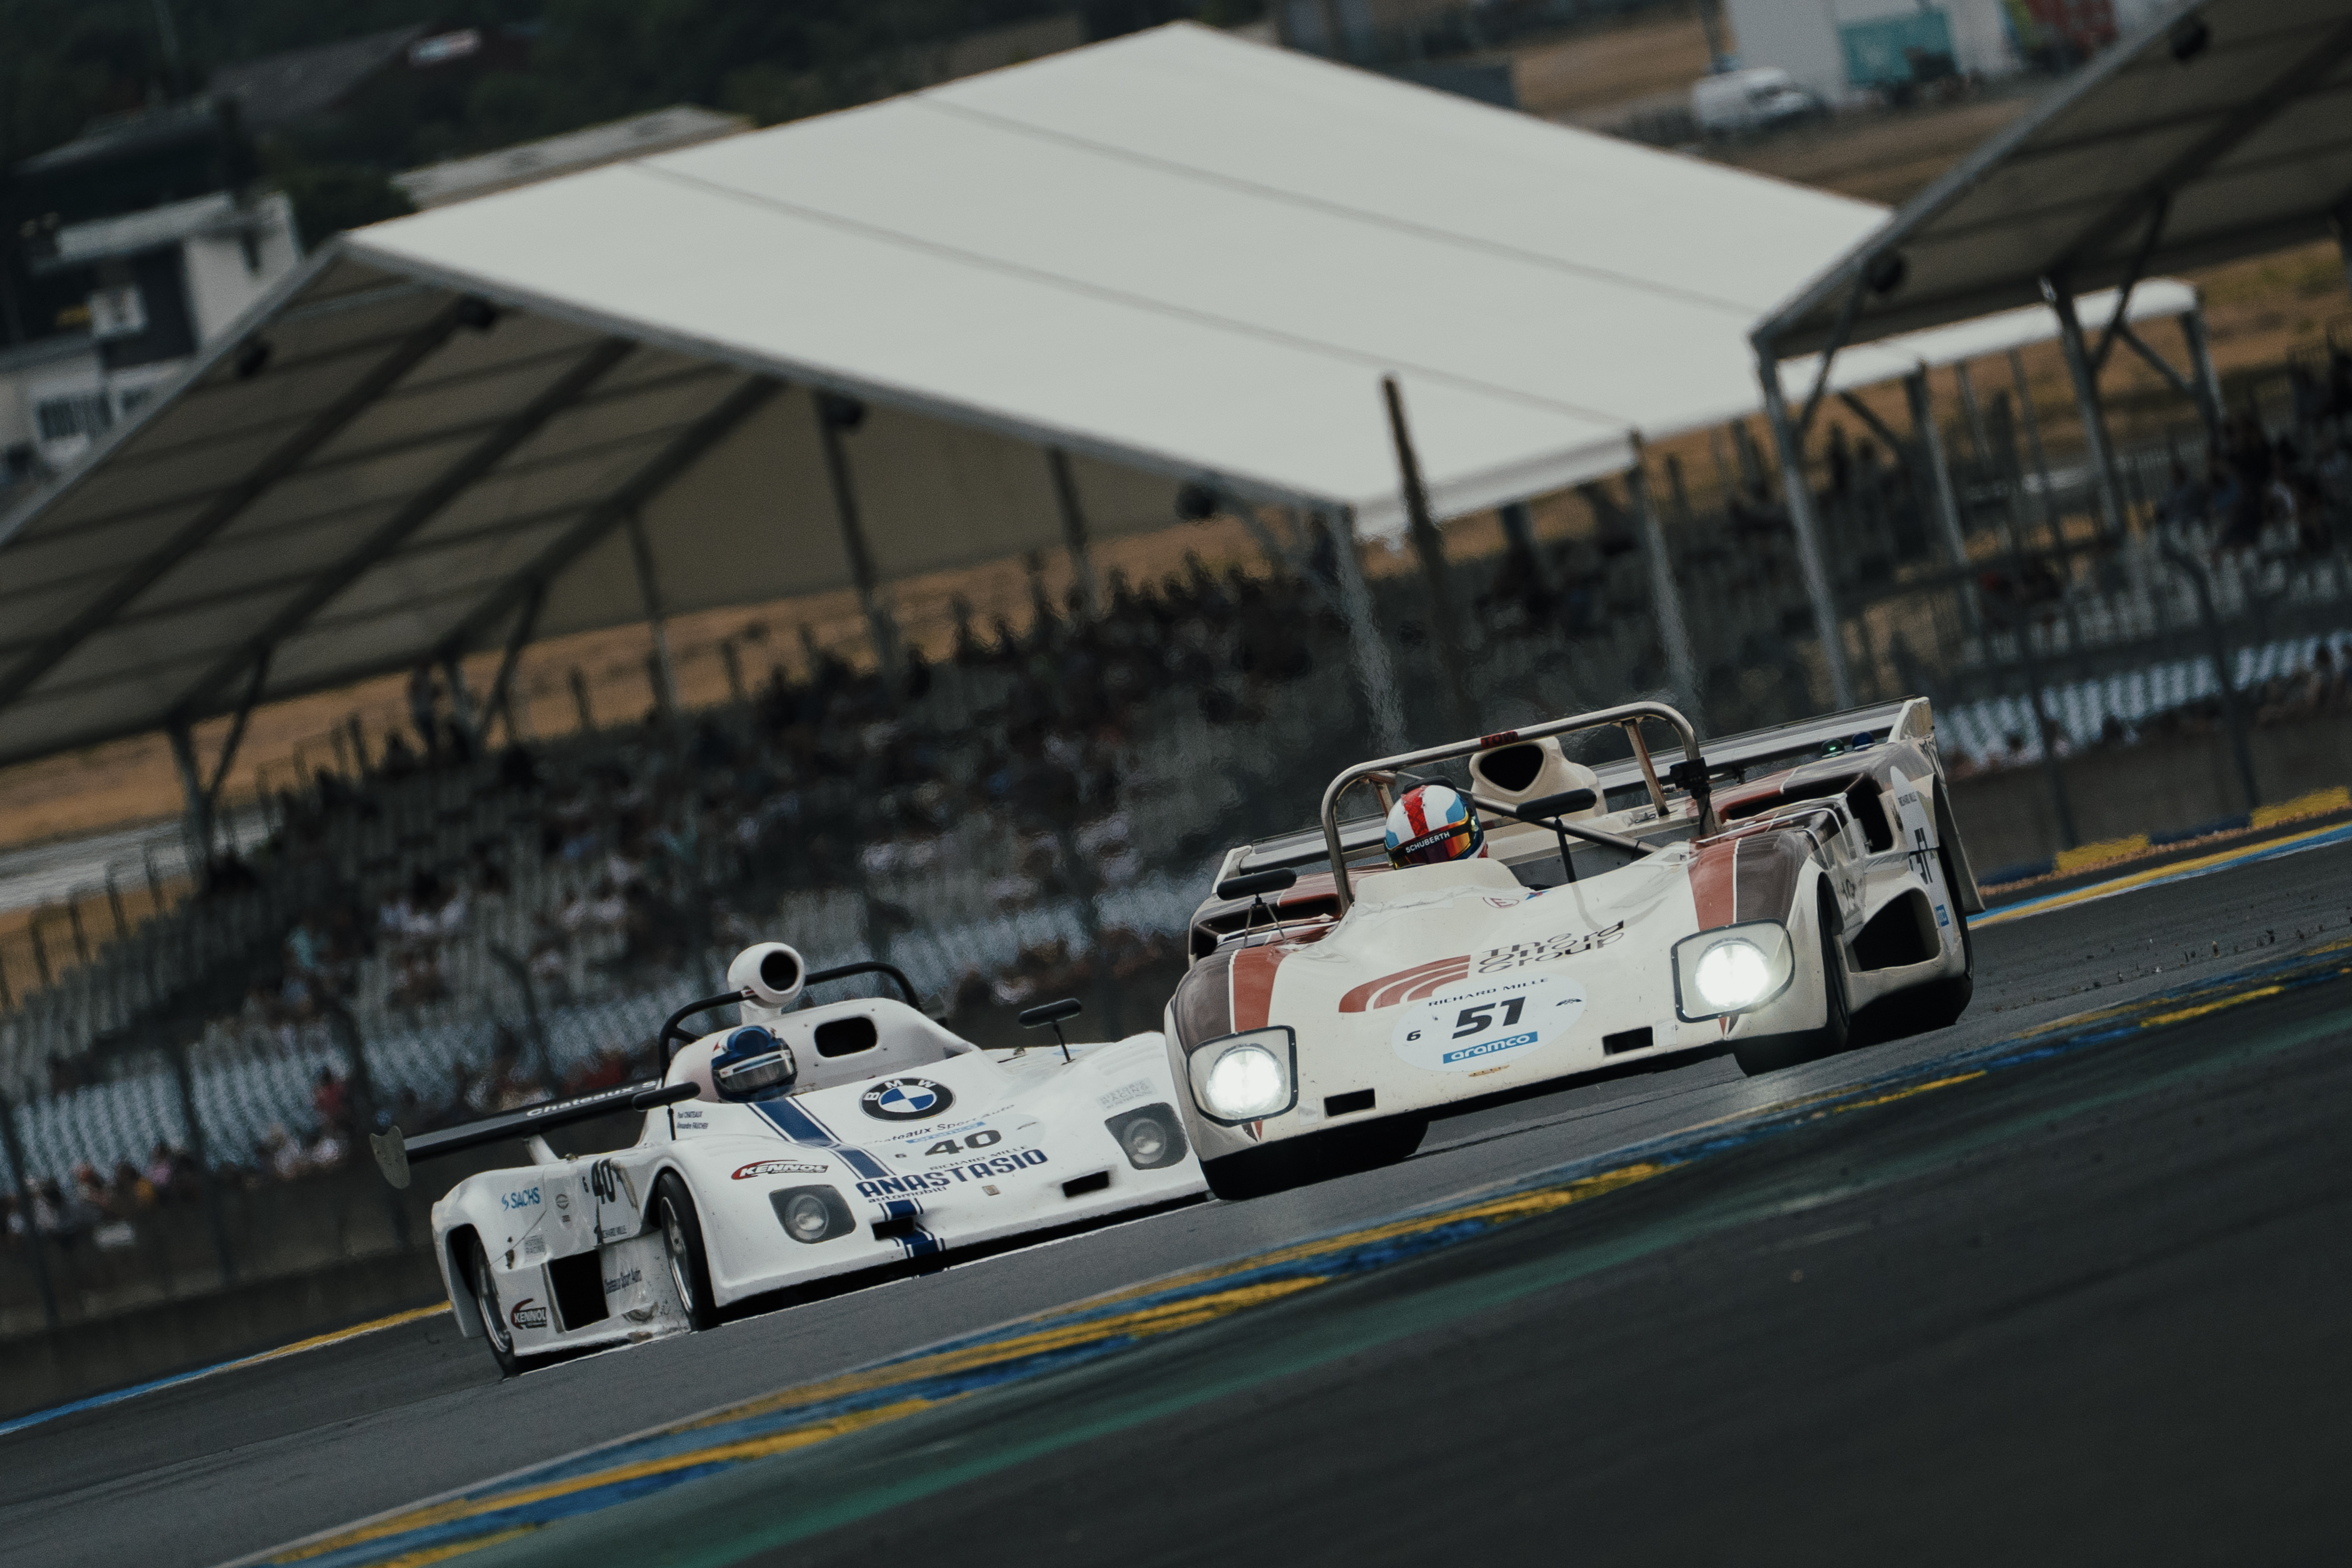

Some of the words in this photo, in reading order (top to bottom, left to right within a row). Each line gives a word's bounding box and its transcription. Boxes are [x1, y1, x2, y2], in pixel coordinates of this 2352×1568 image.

[1482, 731, 1518, 745] TOW
[1406, 831, 1450, 853] SCHUBERTH
[1478, 933, 1624, 973] Group
[1482, 933, 1572, 957] The
[1428, 988, 1497, 1006] RICHARD
[1503, 978, 1548, 991] MILLE
[1406, 1030, 1421, 1042] 6
[1452, 996, 1526, 1039] 51
[1451, 1035, 1530, 1061] aramco
[527, 1087, 634, 1116] Chateaux
[863, 1079, 937, 1101] BMW
[937, 1117, 976, 1131] Sport
[925, 1130, 1002, 1156] 40
[739, 1164, 827, 1177] KENNOL
[856, 1149, 1048, 1198] ANASTASIO
[929, 1156, 986, 1171] RICHARD
[591, 1157, 616, 1205] 40
[511, 1187, 540, 1209] SACHS
[868, 1186, 947, 1203] automobili
[515, 1309, 546, 1323] KENNOL
